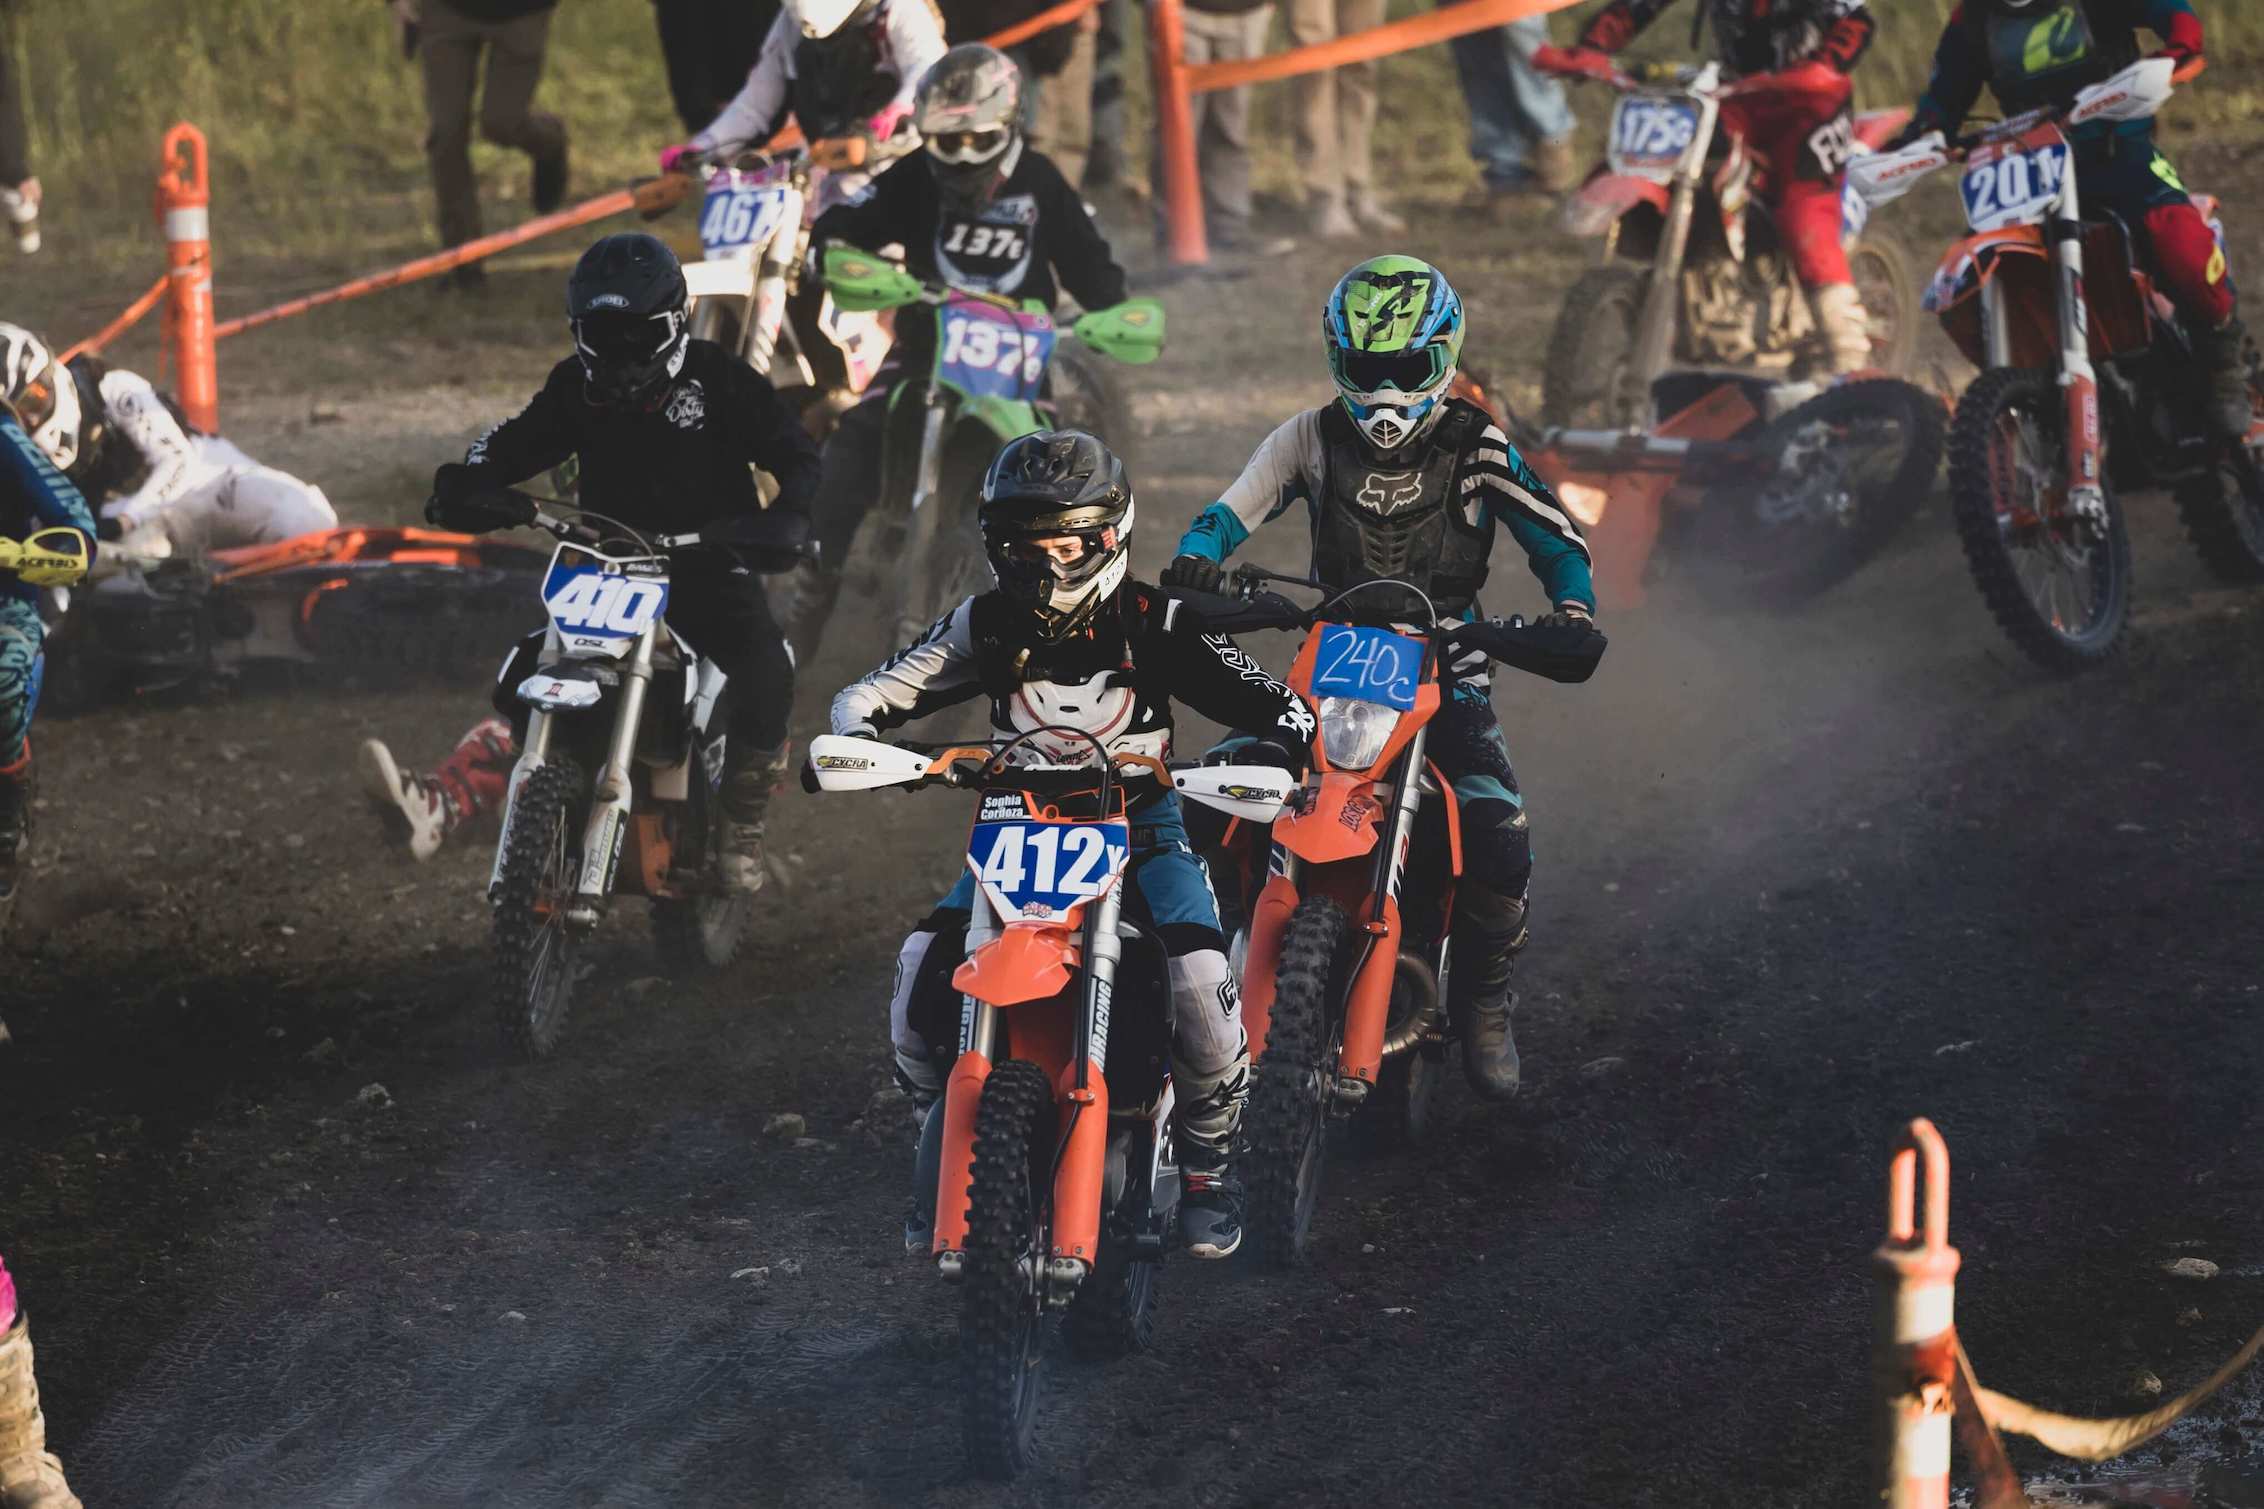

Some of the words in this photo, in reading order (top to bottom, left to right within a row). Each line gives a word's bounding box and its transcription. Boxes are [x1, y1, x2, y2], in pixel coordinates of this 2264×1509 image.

[832, 757, 867, 769] CYCRA
[985, 794, 1022, 810] Sophia
[980, 806, 1024, 820] Cordoza
